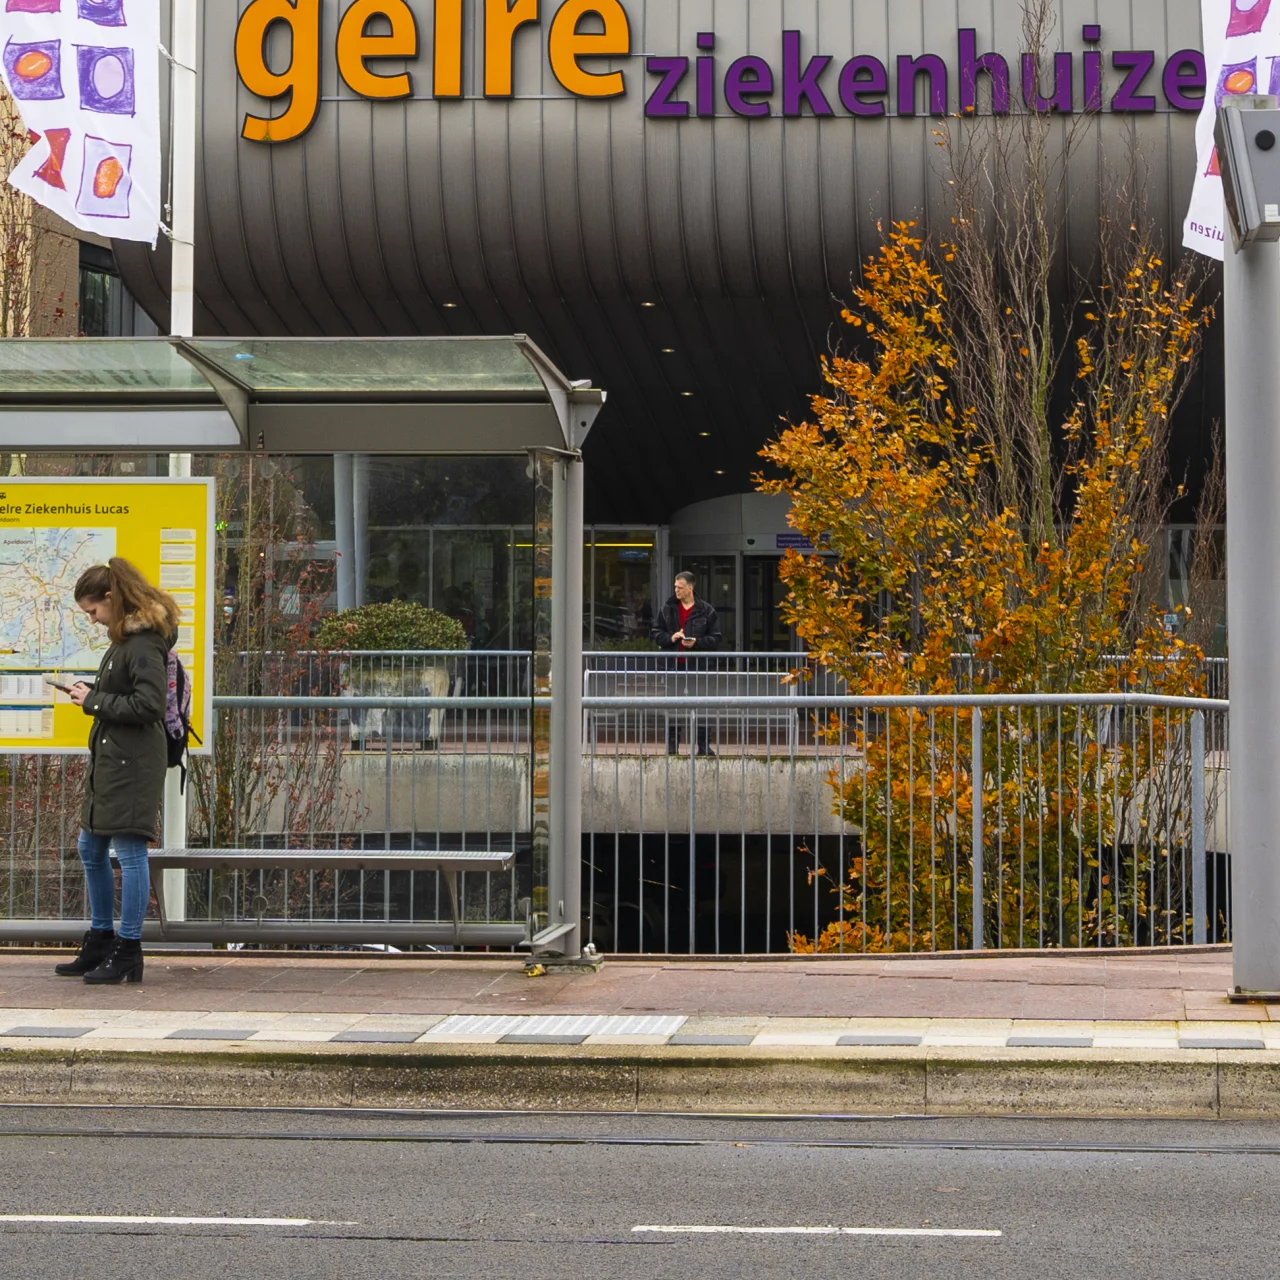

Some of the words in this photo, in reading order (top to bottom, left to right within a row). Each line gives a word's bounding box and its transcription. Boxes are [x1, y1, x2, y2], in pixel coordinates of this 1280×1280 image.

[643, 23, 1207, 118] ziekenhuize
[24, 503, 92, 515] Ziekenhuis
[94, 503, 130, 515] Lucas
